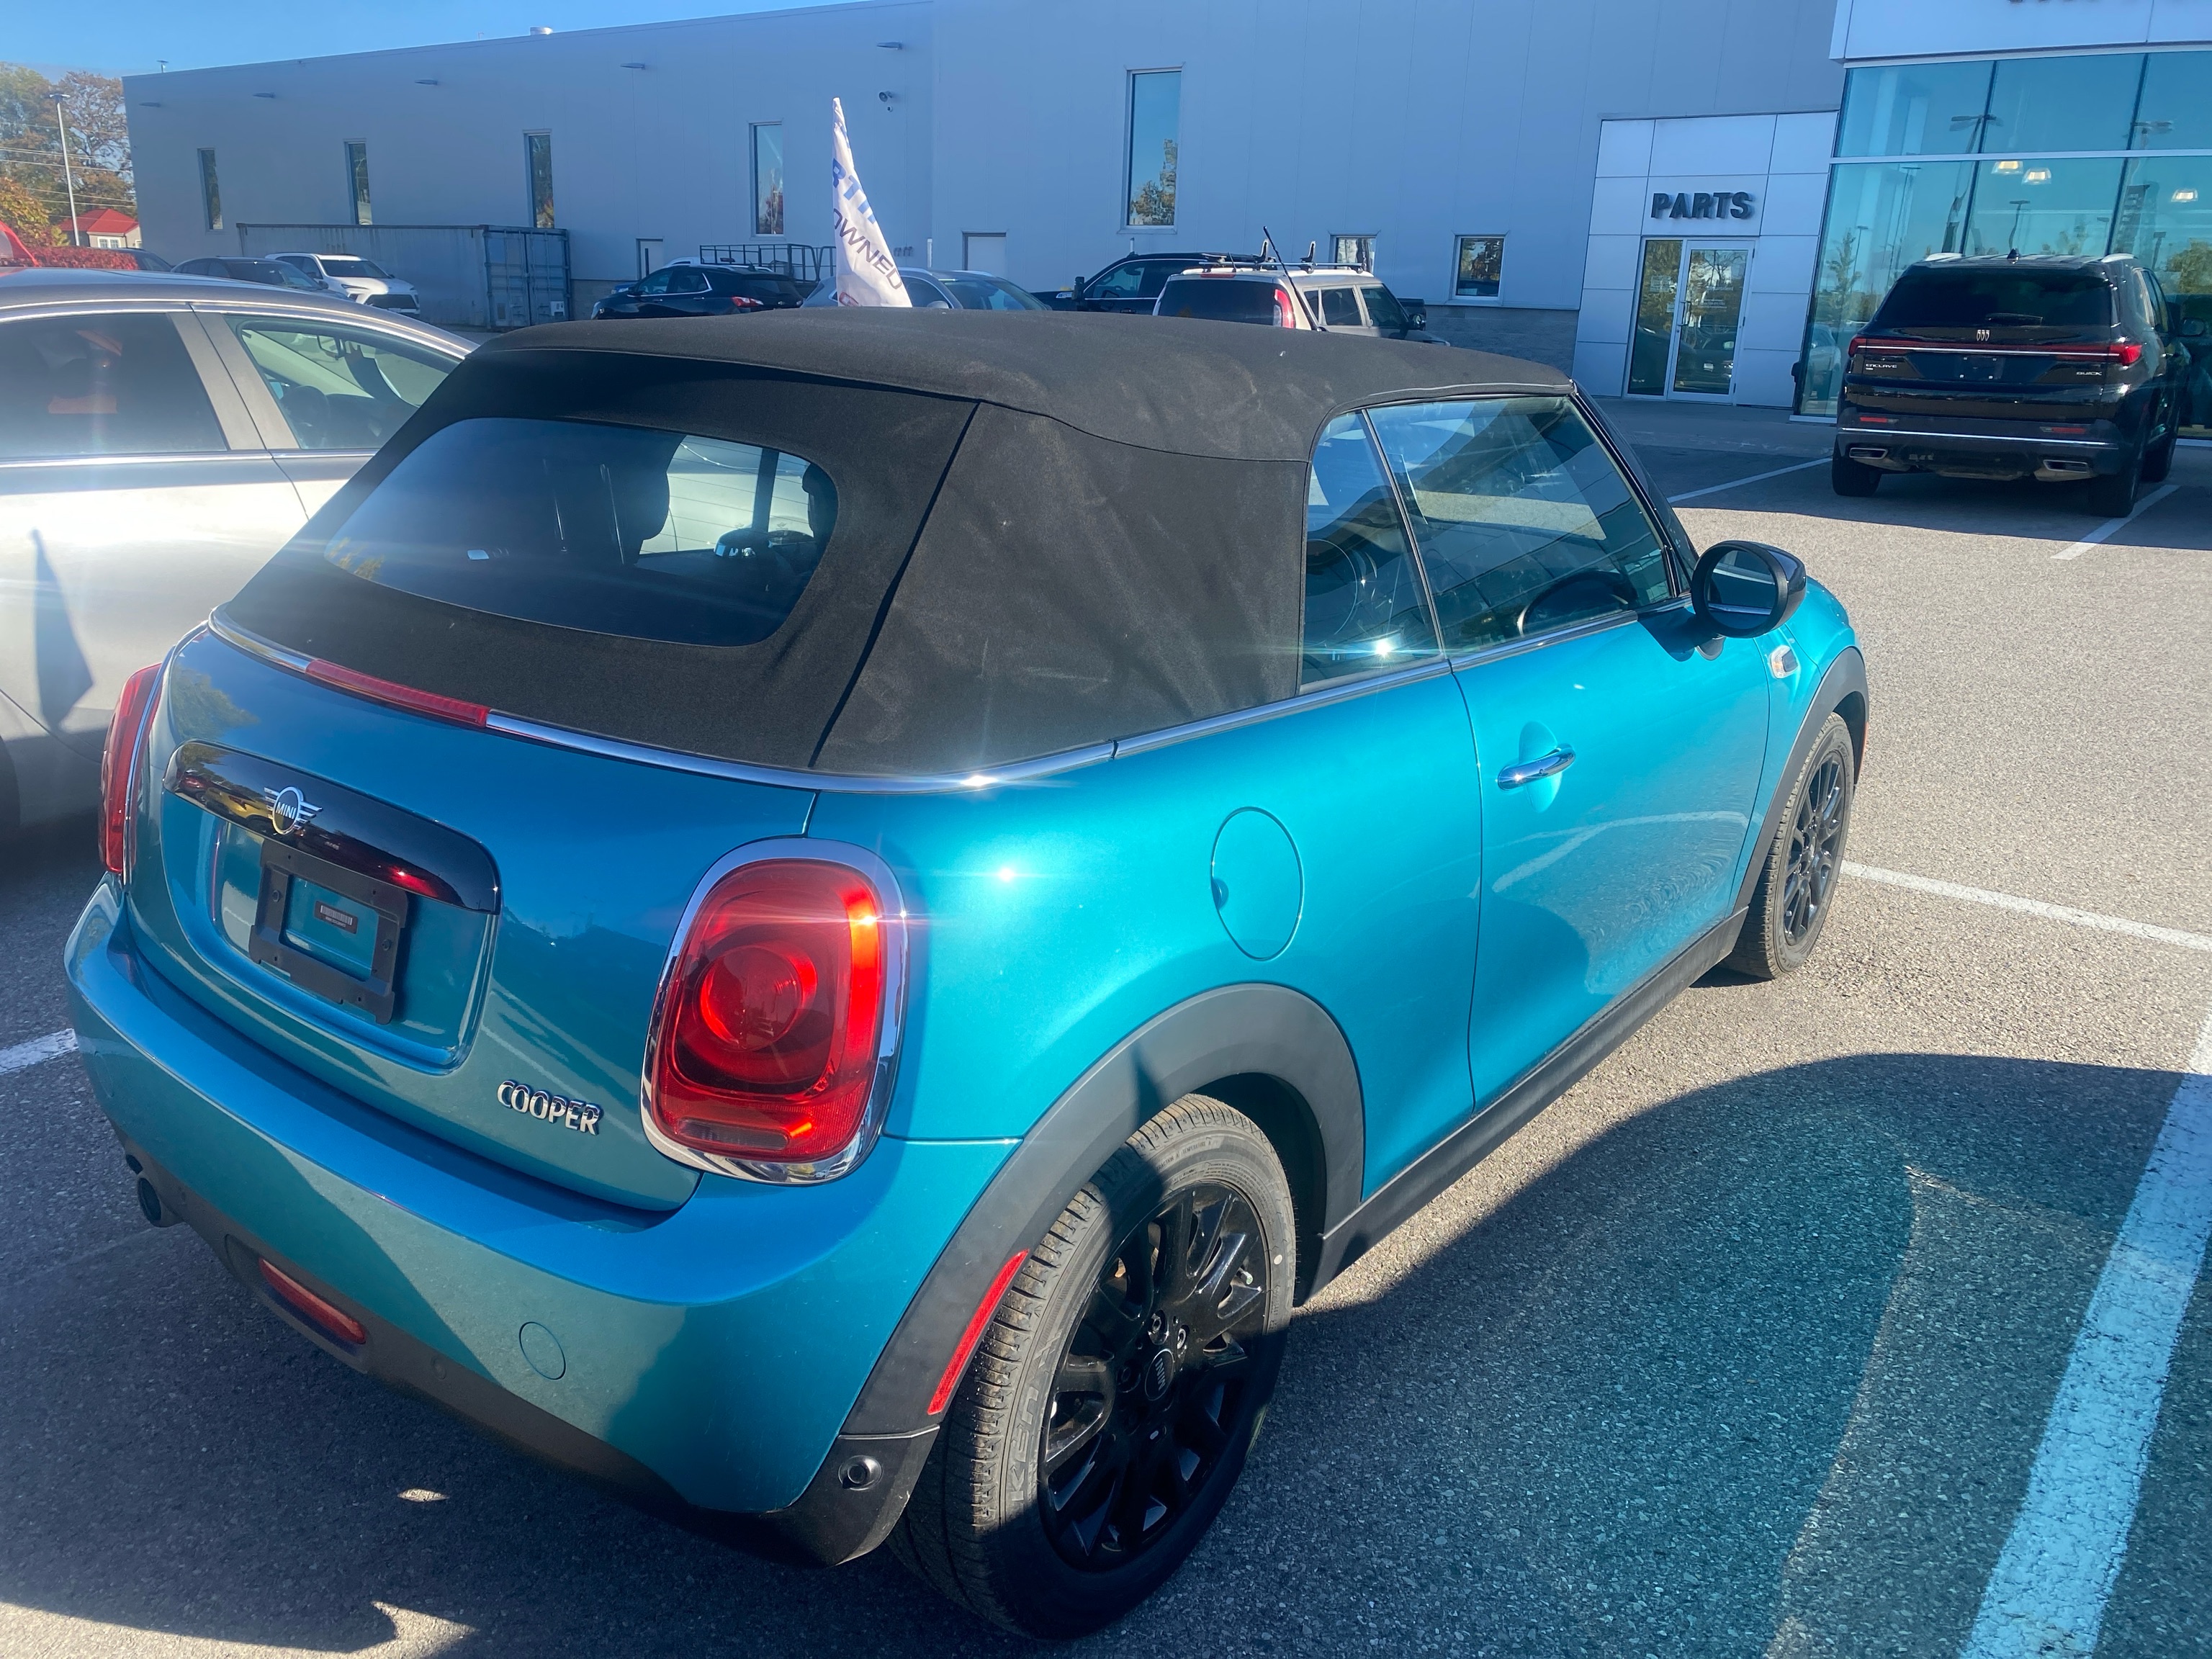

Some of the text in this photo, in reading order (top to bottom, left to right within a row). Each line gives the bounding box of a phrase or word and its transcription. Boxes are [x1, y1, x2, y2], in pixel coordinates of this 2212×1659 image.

[1651, 192, 1754, 218] PARTS
[275, 801, 297, 819] MINI
[497, 1080, 602, 1136] COOPER
[1155, 1357, 1166, 1391] MINI
